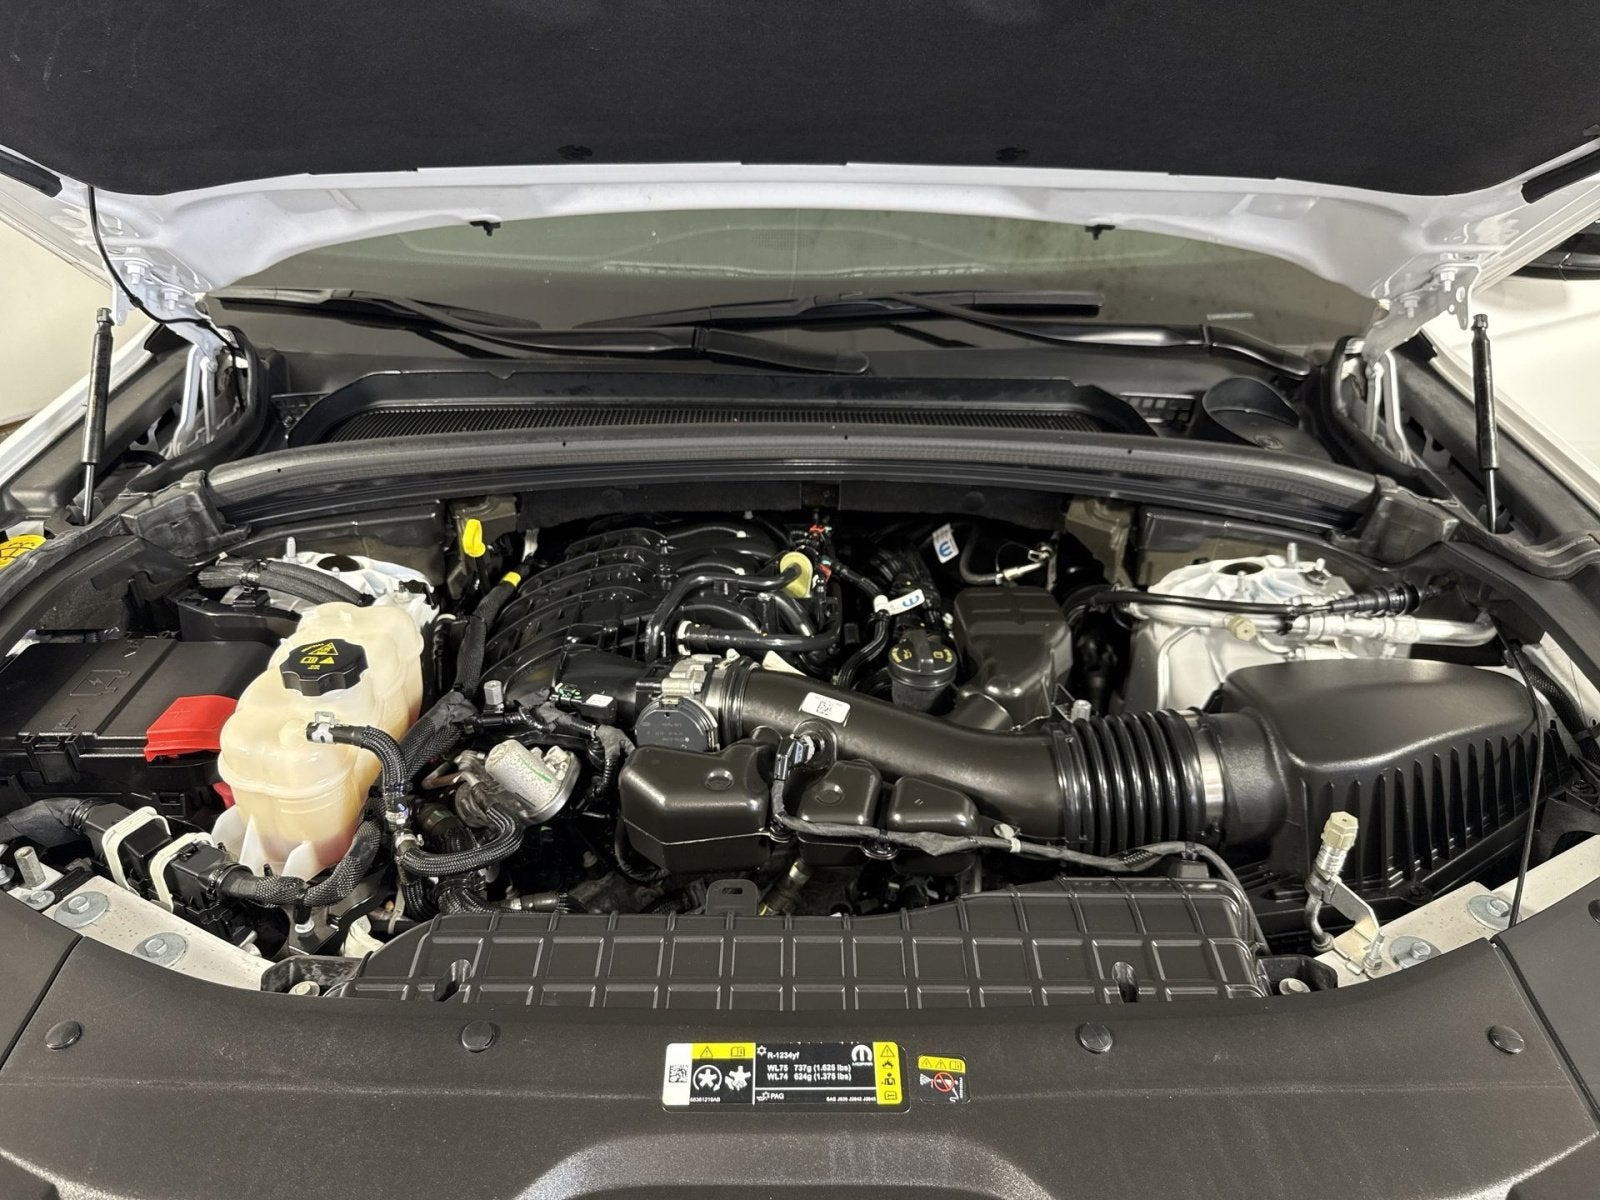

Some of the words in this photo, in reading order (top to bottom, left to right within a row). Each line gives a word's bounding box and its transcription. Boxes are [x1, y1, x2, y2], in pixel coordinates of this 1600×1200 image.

[767, 1051, 800, 1060] R-1234yf
[766, 1064, 789, 1072] WL75
[793, 1064, 812, 1073] 737g
[813, 1064, 836, 1073] (1.625
[837, 1064, 852, 1073] lbs)
[766, 1072, 789, 1081] WL74
[793, 1072, 812, 1082] 624g
[813, 1072, 836, 1082] (1.375
[837, 1072, 852, 1082] lbs)
